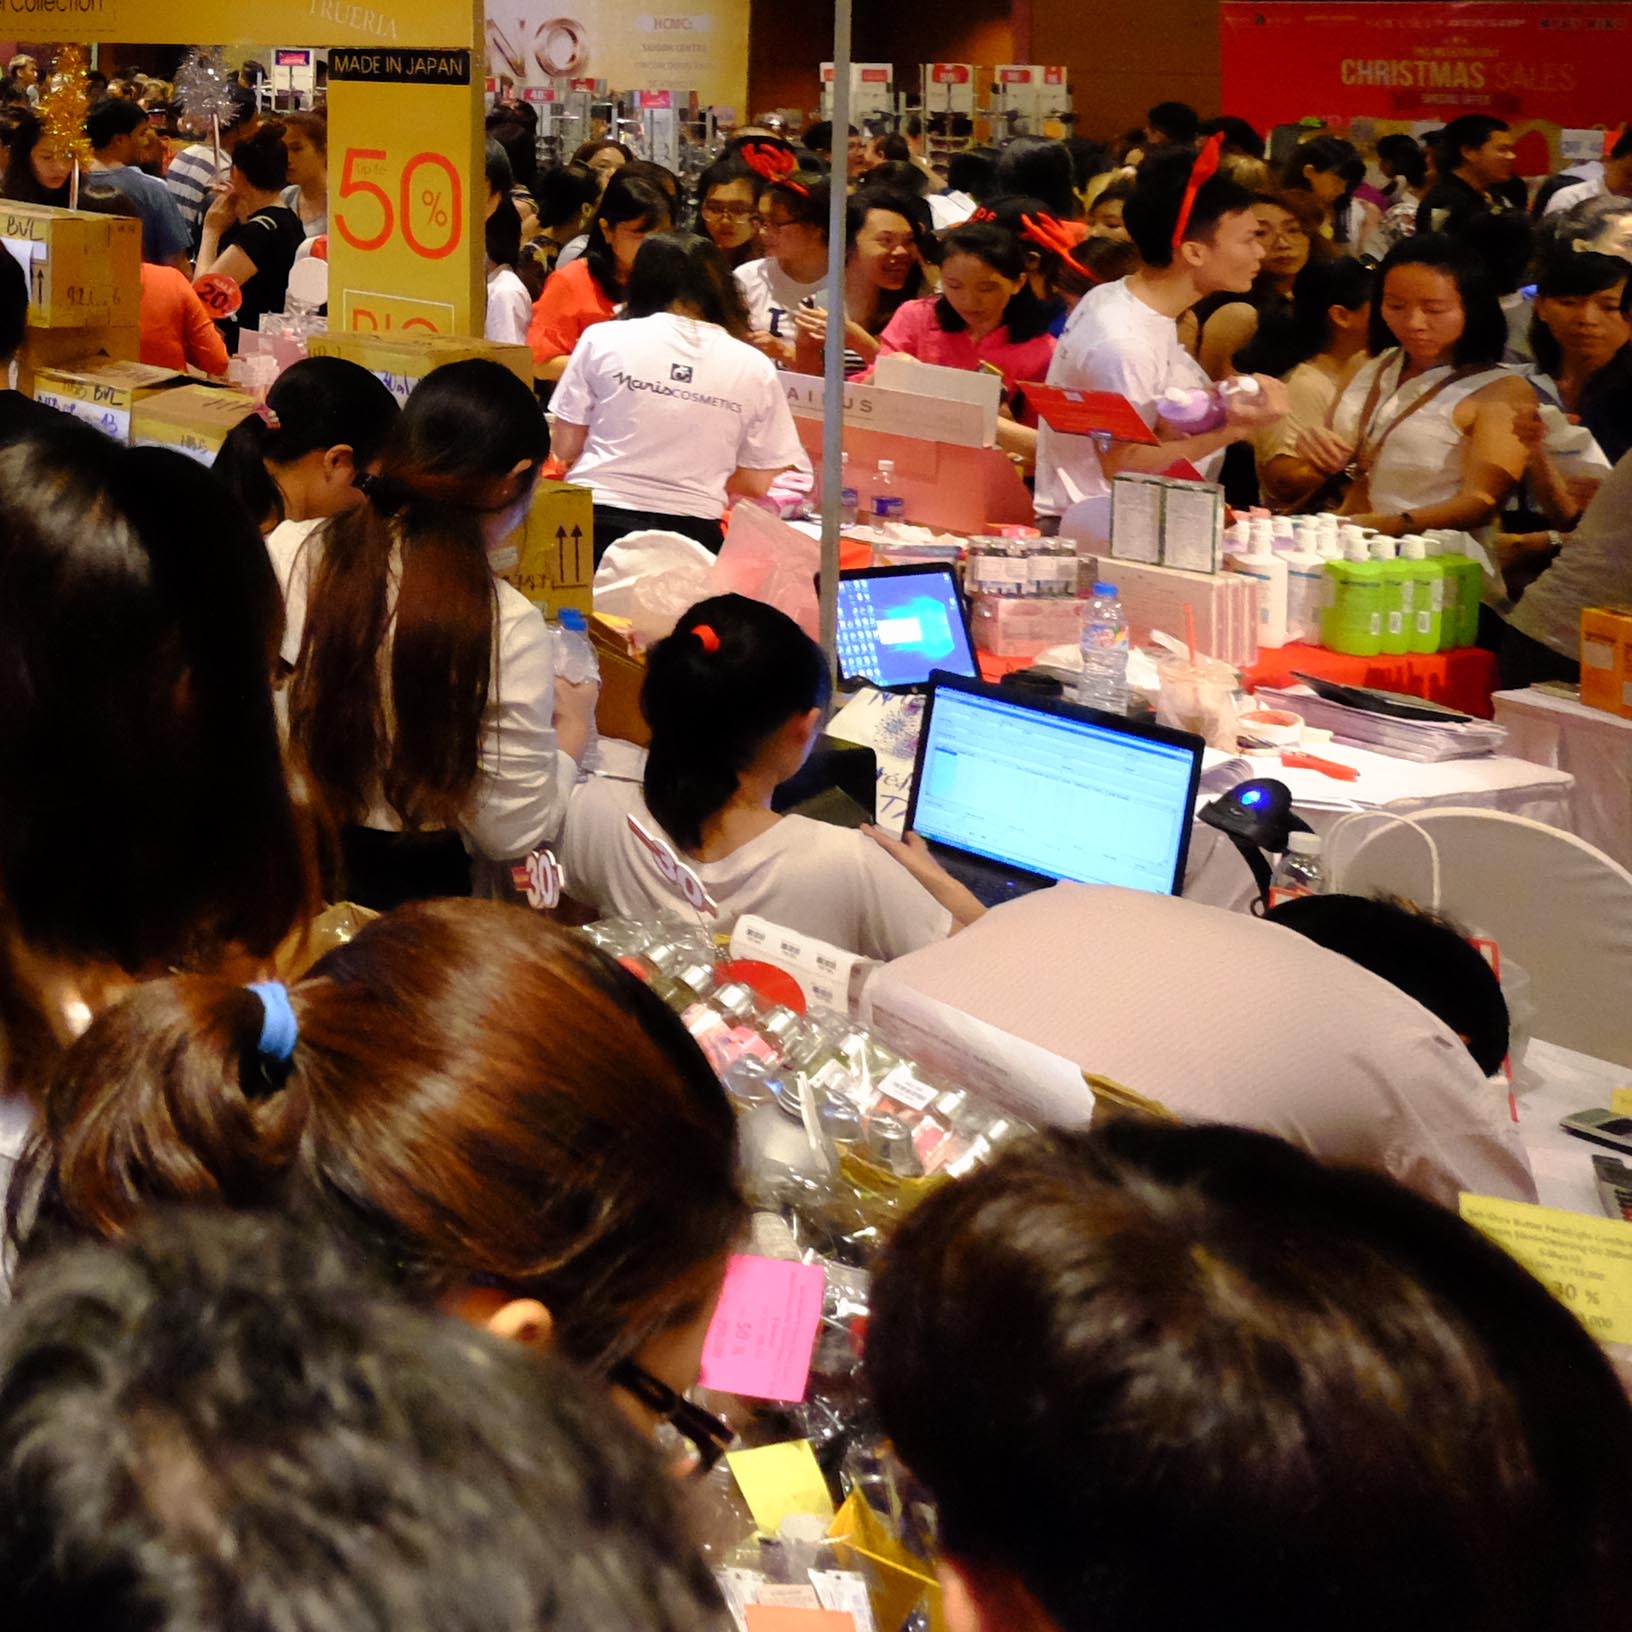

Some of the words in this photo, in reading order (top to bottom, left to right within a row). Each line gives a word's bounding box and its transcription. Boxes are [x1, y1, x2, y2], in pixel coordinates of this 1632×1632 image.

[334, 55, 382, 74] MADE
[386, 56, 402, 75] IN
[406, 57, 463, 76] JAPAN
[1341, 59, 1485, 89] CHRISTMAS
[1495, 62, 1576, 92] SALES
[334, 147, 463, 260] 50%
